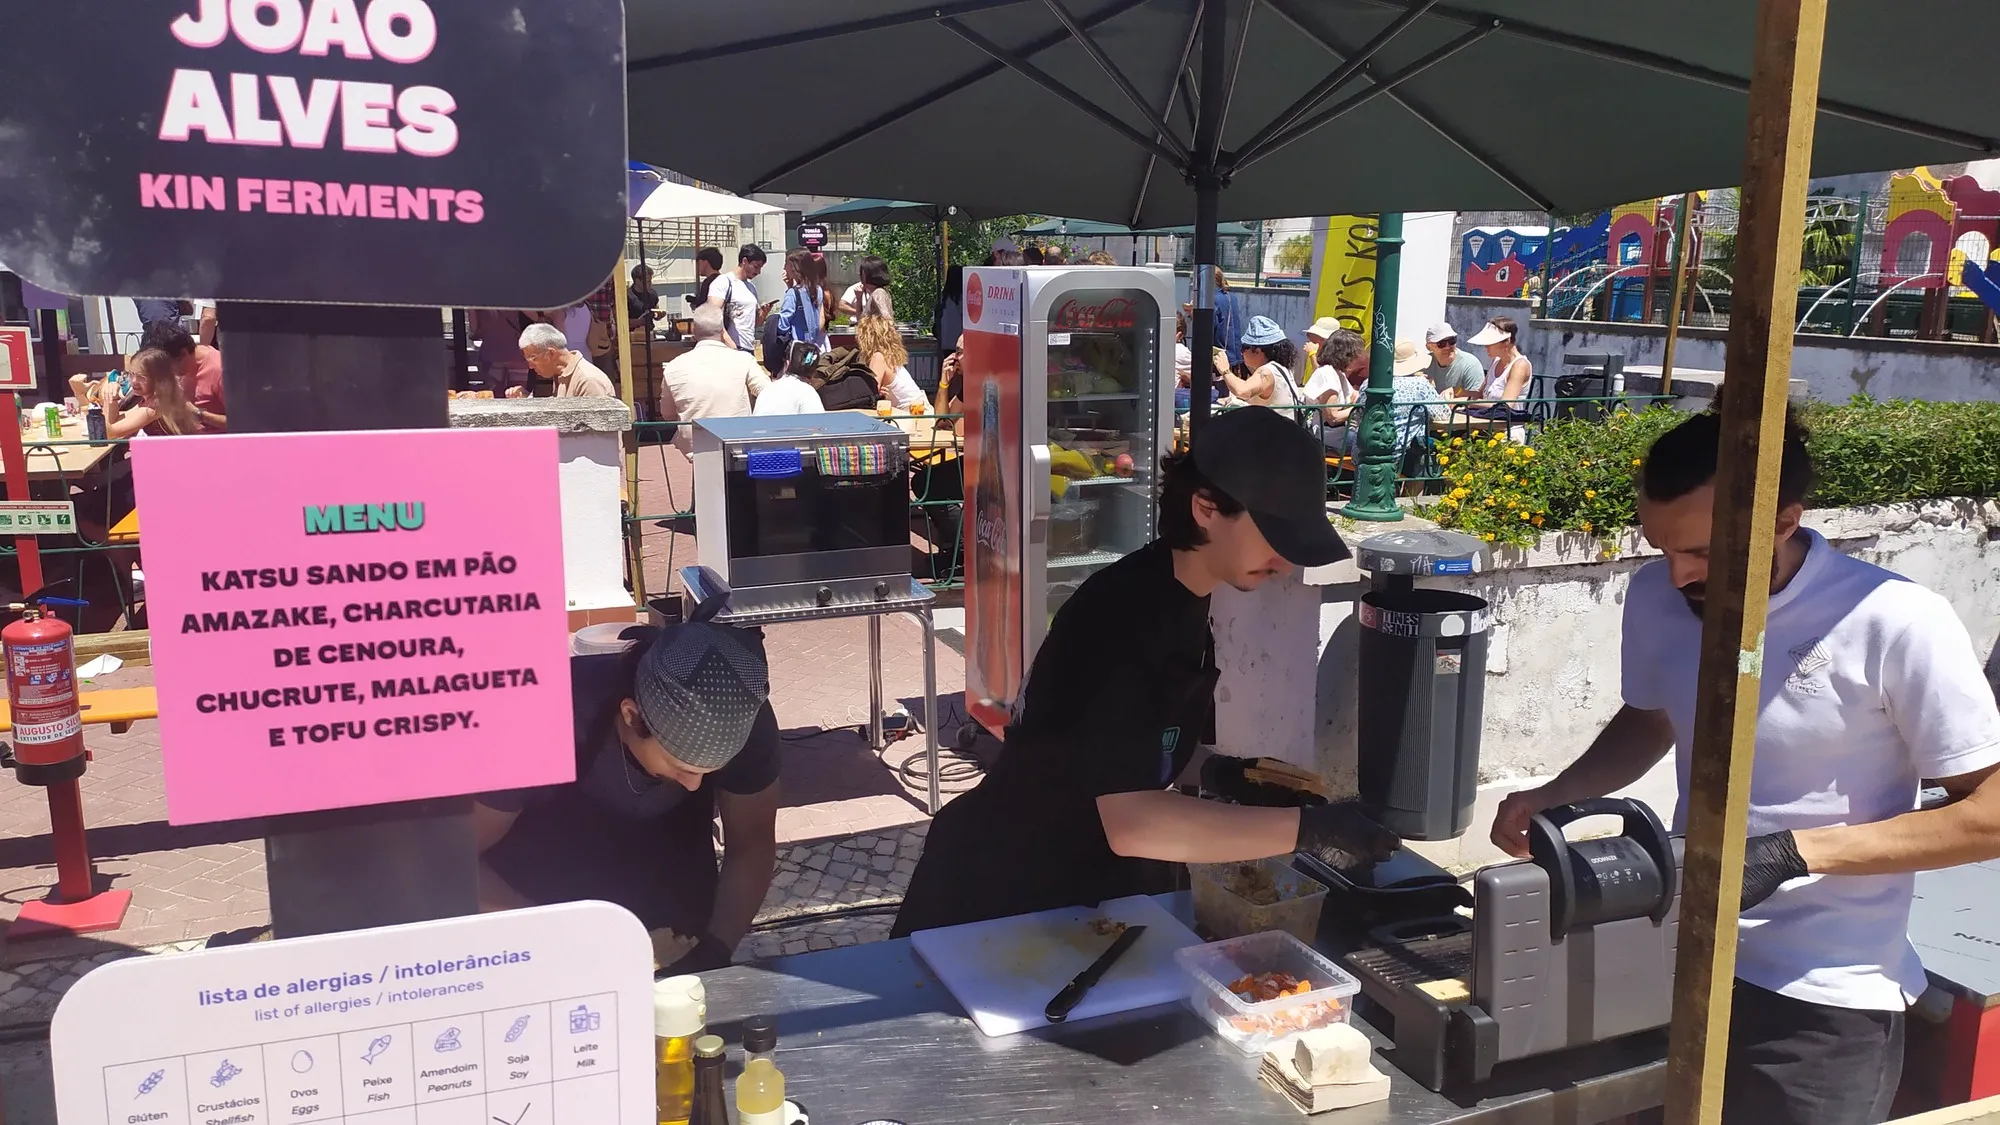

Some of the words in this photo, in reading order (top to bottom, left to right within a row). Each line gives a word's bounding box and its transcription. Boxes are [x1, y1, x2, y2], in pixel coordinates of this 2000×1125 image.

[158, 68, 459, 158] ALVES
[139, 173, 225, 211] KIN
[237, 178, 485, 224] FERMENTS
[987, 286, 1016, 301] DRINK
[303, 500, 426, 535] MENU
[201, 567, 299, 592] KATSU
[306, 561, 409, 585] SANDO
[415, 558, 457, 580] EM
[464, 551, 517, 576] PÃO
[180, 605, 338, 634] AMAZAKE,
[342, 592, 541, 623] CHARCUTARIA
[273, 647, 311, 668] DE
[317, 636, 464, 665] CENOURA,
[195, 682, 365, 714] CHUCRUTE,
[371, 667, 539, 699] MALAGUETA
[19, 723, 64, 736] AUGUSTO
[268, 728, 286, 747] E
[292, 720, 367, 745] TOFU
[373, 710, 480, 738] CRISPY.
[198, 988, 248, 1006] lista
[253, 983, 281, 999] de
[286, 971, 374, 992] alergias
[378, 965, 389, 984] /
[394, 948, 532, 980] intolerâncias
[254, 1007, 280, 1022] list
[283, 1004, 300, 1018] of
[303, 995, 372, 1014] allergies
[375, 992, 384, 1006] /
[387, 979, 485, 1003] intolerances
[573, 1043, 599, 1054] Leite
[506, 1054, 530, 1066] Soja
[576, 1058, 596, 1069] Milk
[420, 1062, 478, 1079] Amendoim
[509, 1070, 529, 1081] Soy
[362, 1075, 393, 1087] Peixe
[427, 1079, 473, 1094] Peanuts
[289, 1087, 319, 1099] Ovos
[367, 1091, 390, 1103] Fish
[196, 1095, 261, 1113] Crustácios
[291, 1103, 320, 1117] Eggs
[127, 1109, 169, 1125] Glúten
[205, 1112, 255, 1125] Shellfish
